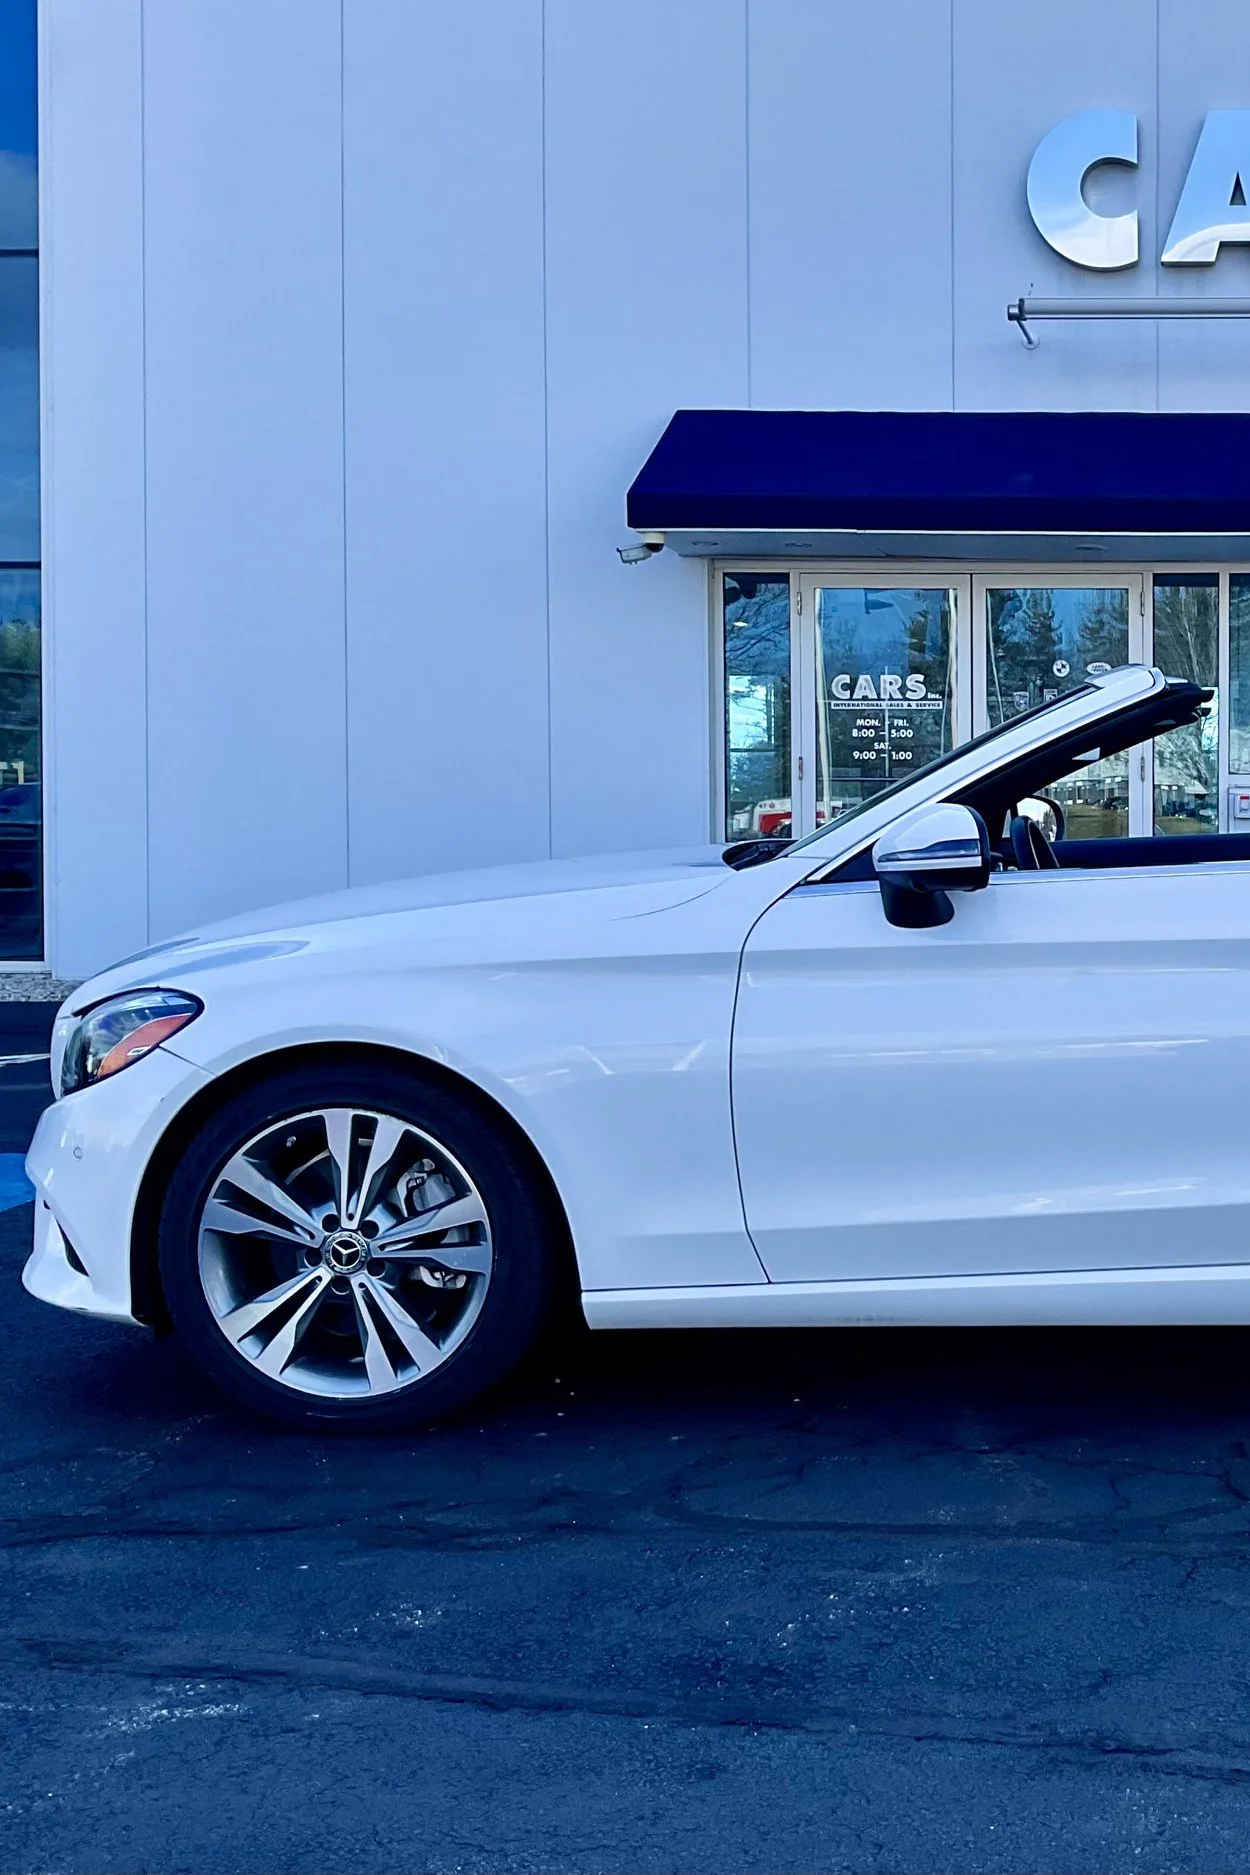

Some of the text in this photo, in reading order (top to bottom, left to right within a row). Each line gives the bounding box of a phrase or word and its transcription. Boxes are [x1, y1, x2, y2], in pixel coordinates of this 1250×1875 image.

[831, 673, 927, 699] CARS
[856, 719, 881, 727] MON.
[894, 719, 909, 727] FRI.
[852, 729, 876, 738] 8:00
[890, 729, 914, 738] 5:00
[873, 742, 892, 750] SAT.
[853, 751, 876, 760] 9:00
[891, 751, 913, 760] 1:00
